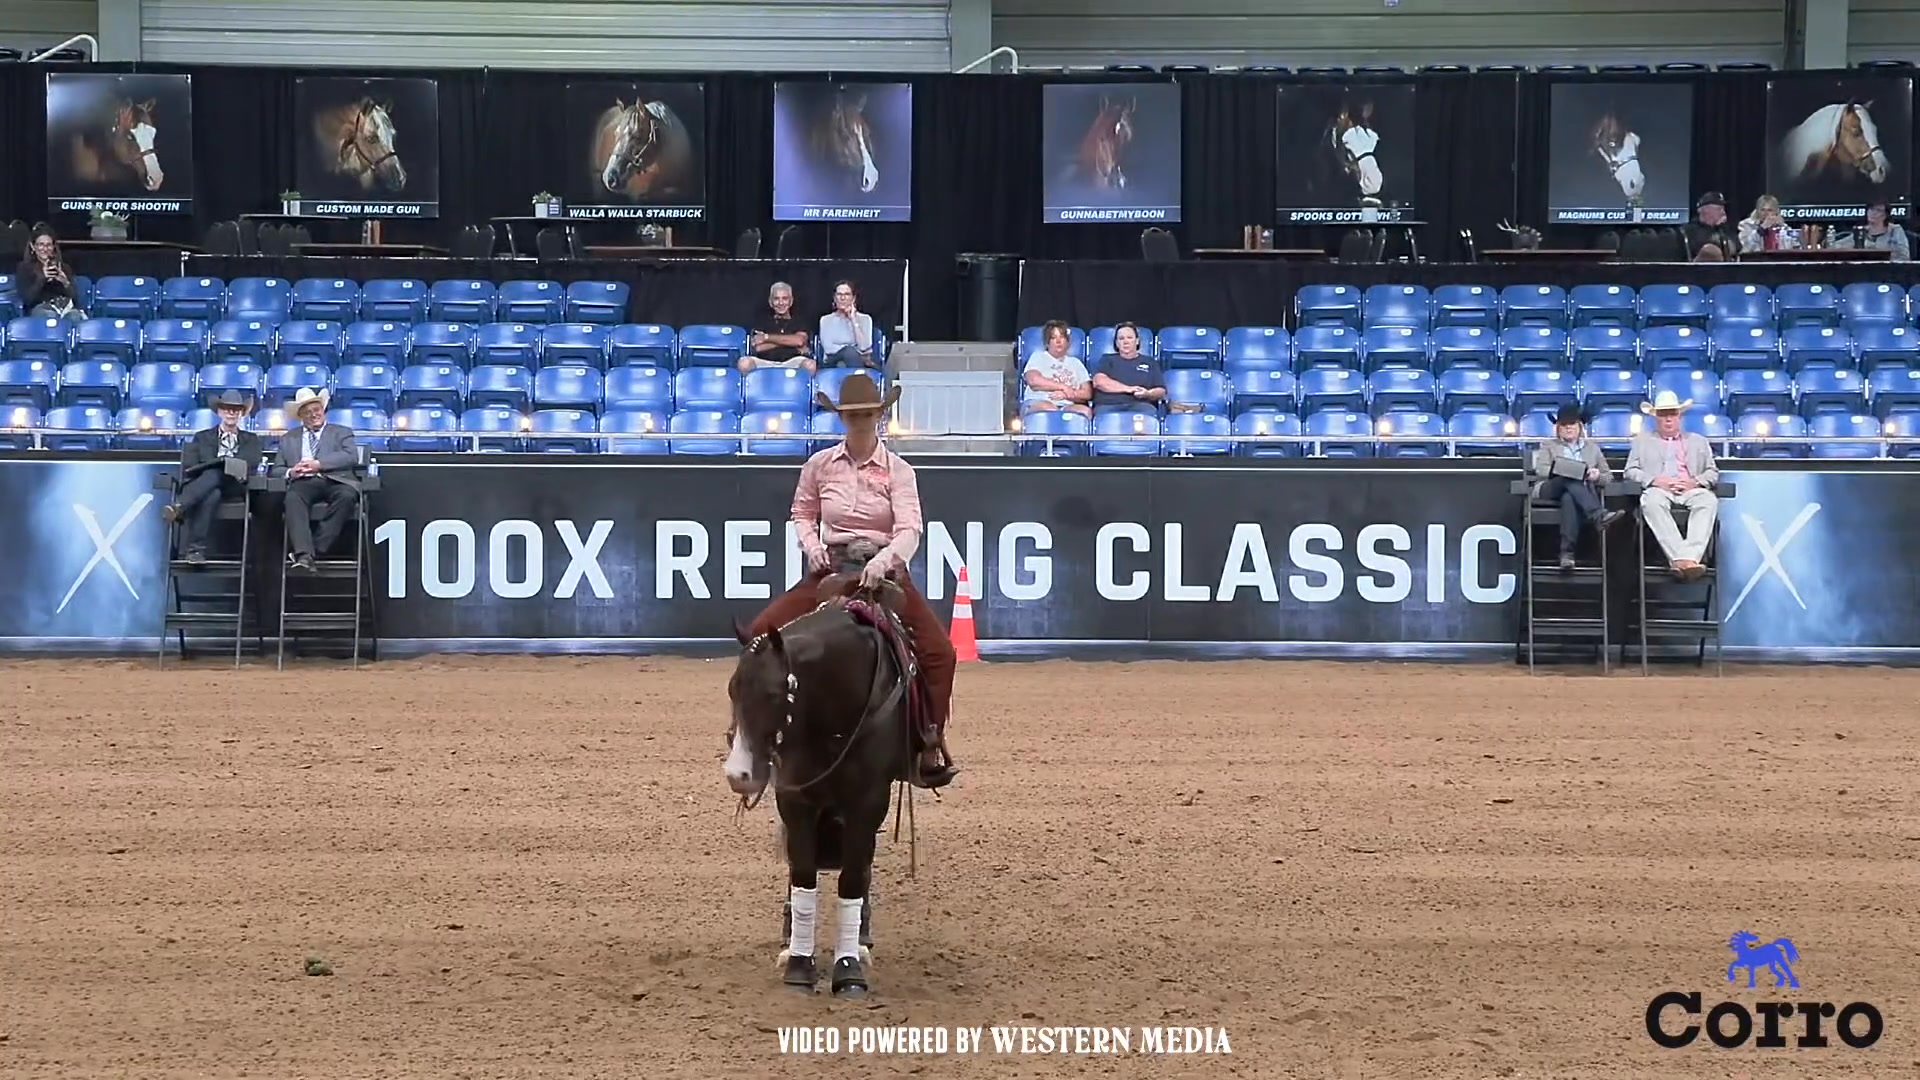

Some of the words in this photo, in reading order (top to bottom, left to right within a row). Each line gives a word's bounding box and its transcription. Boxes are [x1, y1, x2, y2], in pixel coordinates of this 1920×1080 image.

[61, 201, 92, 210] GUNS
[95, 202, 103, 210] R
[105, 202, 128, 211] FOR
[130, 202, 180, 211] SHOOTIN
[316, 204, 361, 213] CUSTOM
[363, 205, 394, 214] MADE
[396, 205, 420, 214] GUN
[569, 209, 605, 218] WALLA
[607, 209, 643, 218] WALLA
[645, 209, 702, 218] STARBUCK
[803, 208, 820, 217] MR
[822, 209, 880, 218] FARENHEIT
[1060, 210, 1165, 219] GUNNABETMYBOON
[1290, 212, 1333, 221] SPOOKS
[1335, 212, 1363, 221] GOTT
[1558, 211, 1605, 220] MAGNUMS
[1647, 212, 1680, 220] DREAM
[374, 518, 615, 600] 100X
[655, 519, 1053, 601] REING
[1094, 521, 1517, 605] CLASSIC
